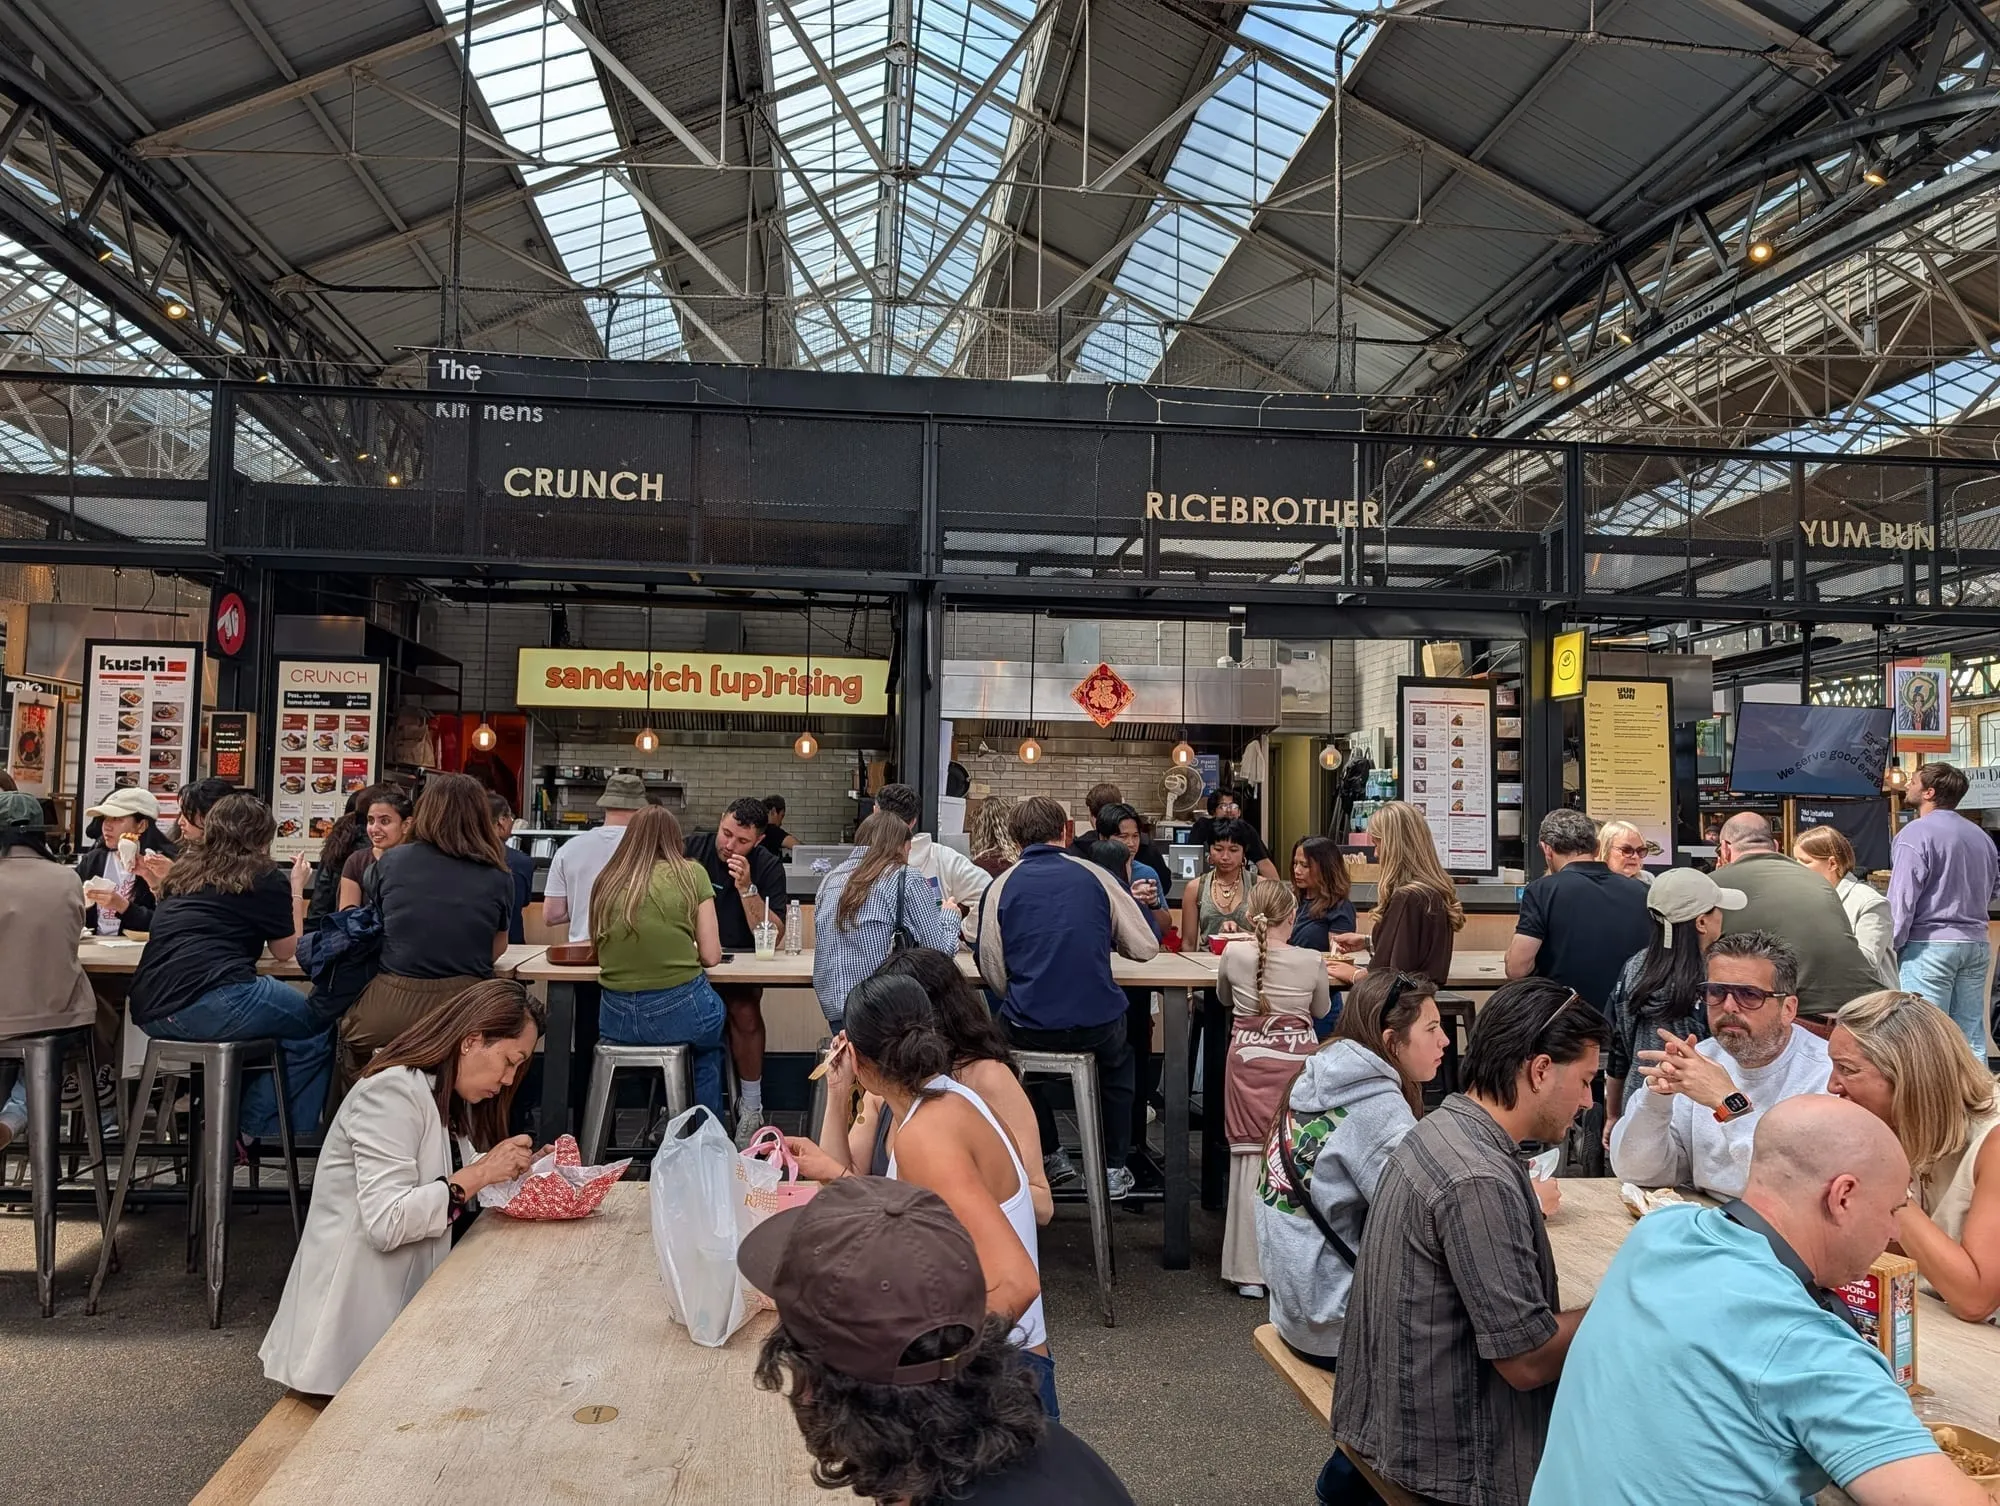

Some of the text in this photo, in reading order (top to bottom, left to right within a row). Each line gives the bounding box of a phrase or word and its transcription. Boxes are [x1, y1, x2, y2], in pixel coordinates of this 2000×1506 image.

[438, 358, 482, 381] The
[504, 467, 664, 502] CRUNCH
[1146, 491, 1380, 528] RICEBROTHER
[1800, 520, 1935, 551] YUM BUN
[99, 655, 166, 672] kushi
[290, 669, 368, 684] CRUNCH
[545, 661, 863, 705] sandwich [up]rising
[1088, 679, 1118, 709] 福
[1776, 766, 1795, 781] We
[1795, 750, 1826, 770] serve
[1829, 749, 1860, 765] good
[1846, 1294, 1867, 1305] CUP
